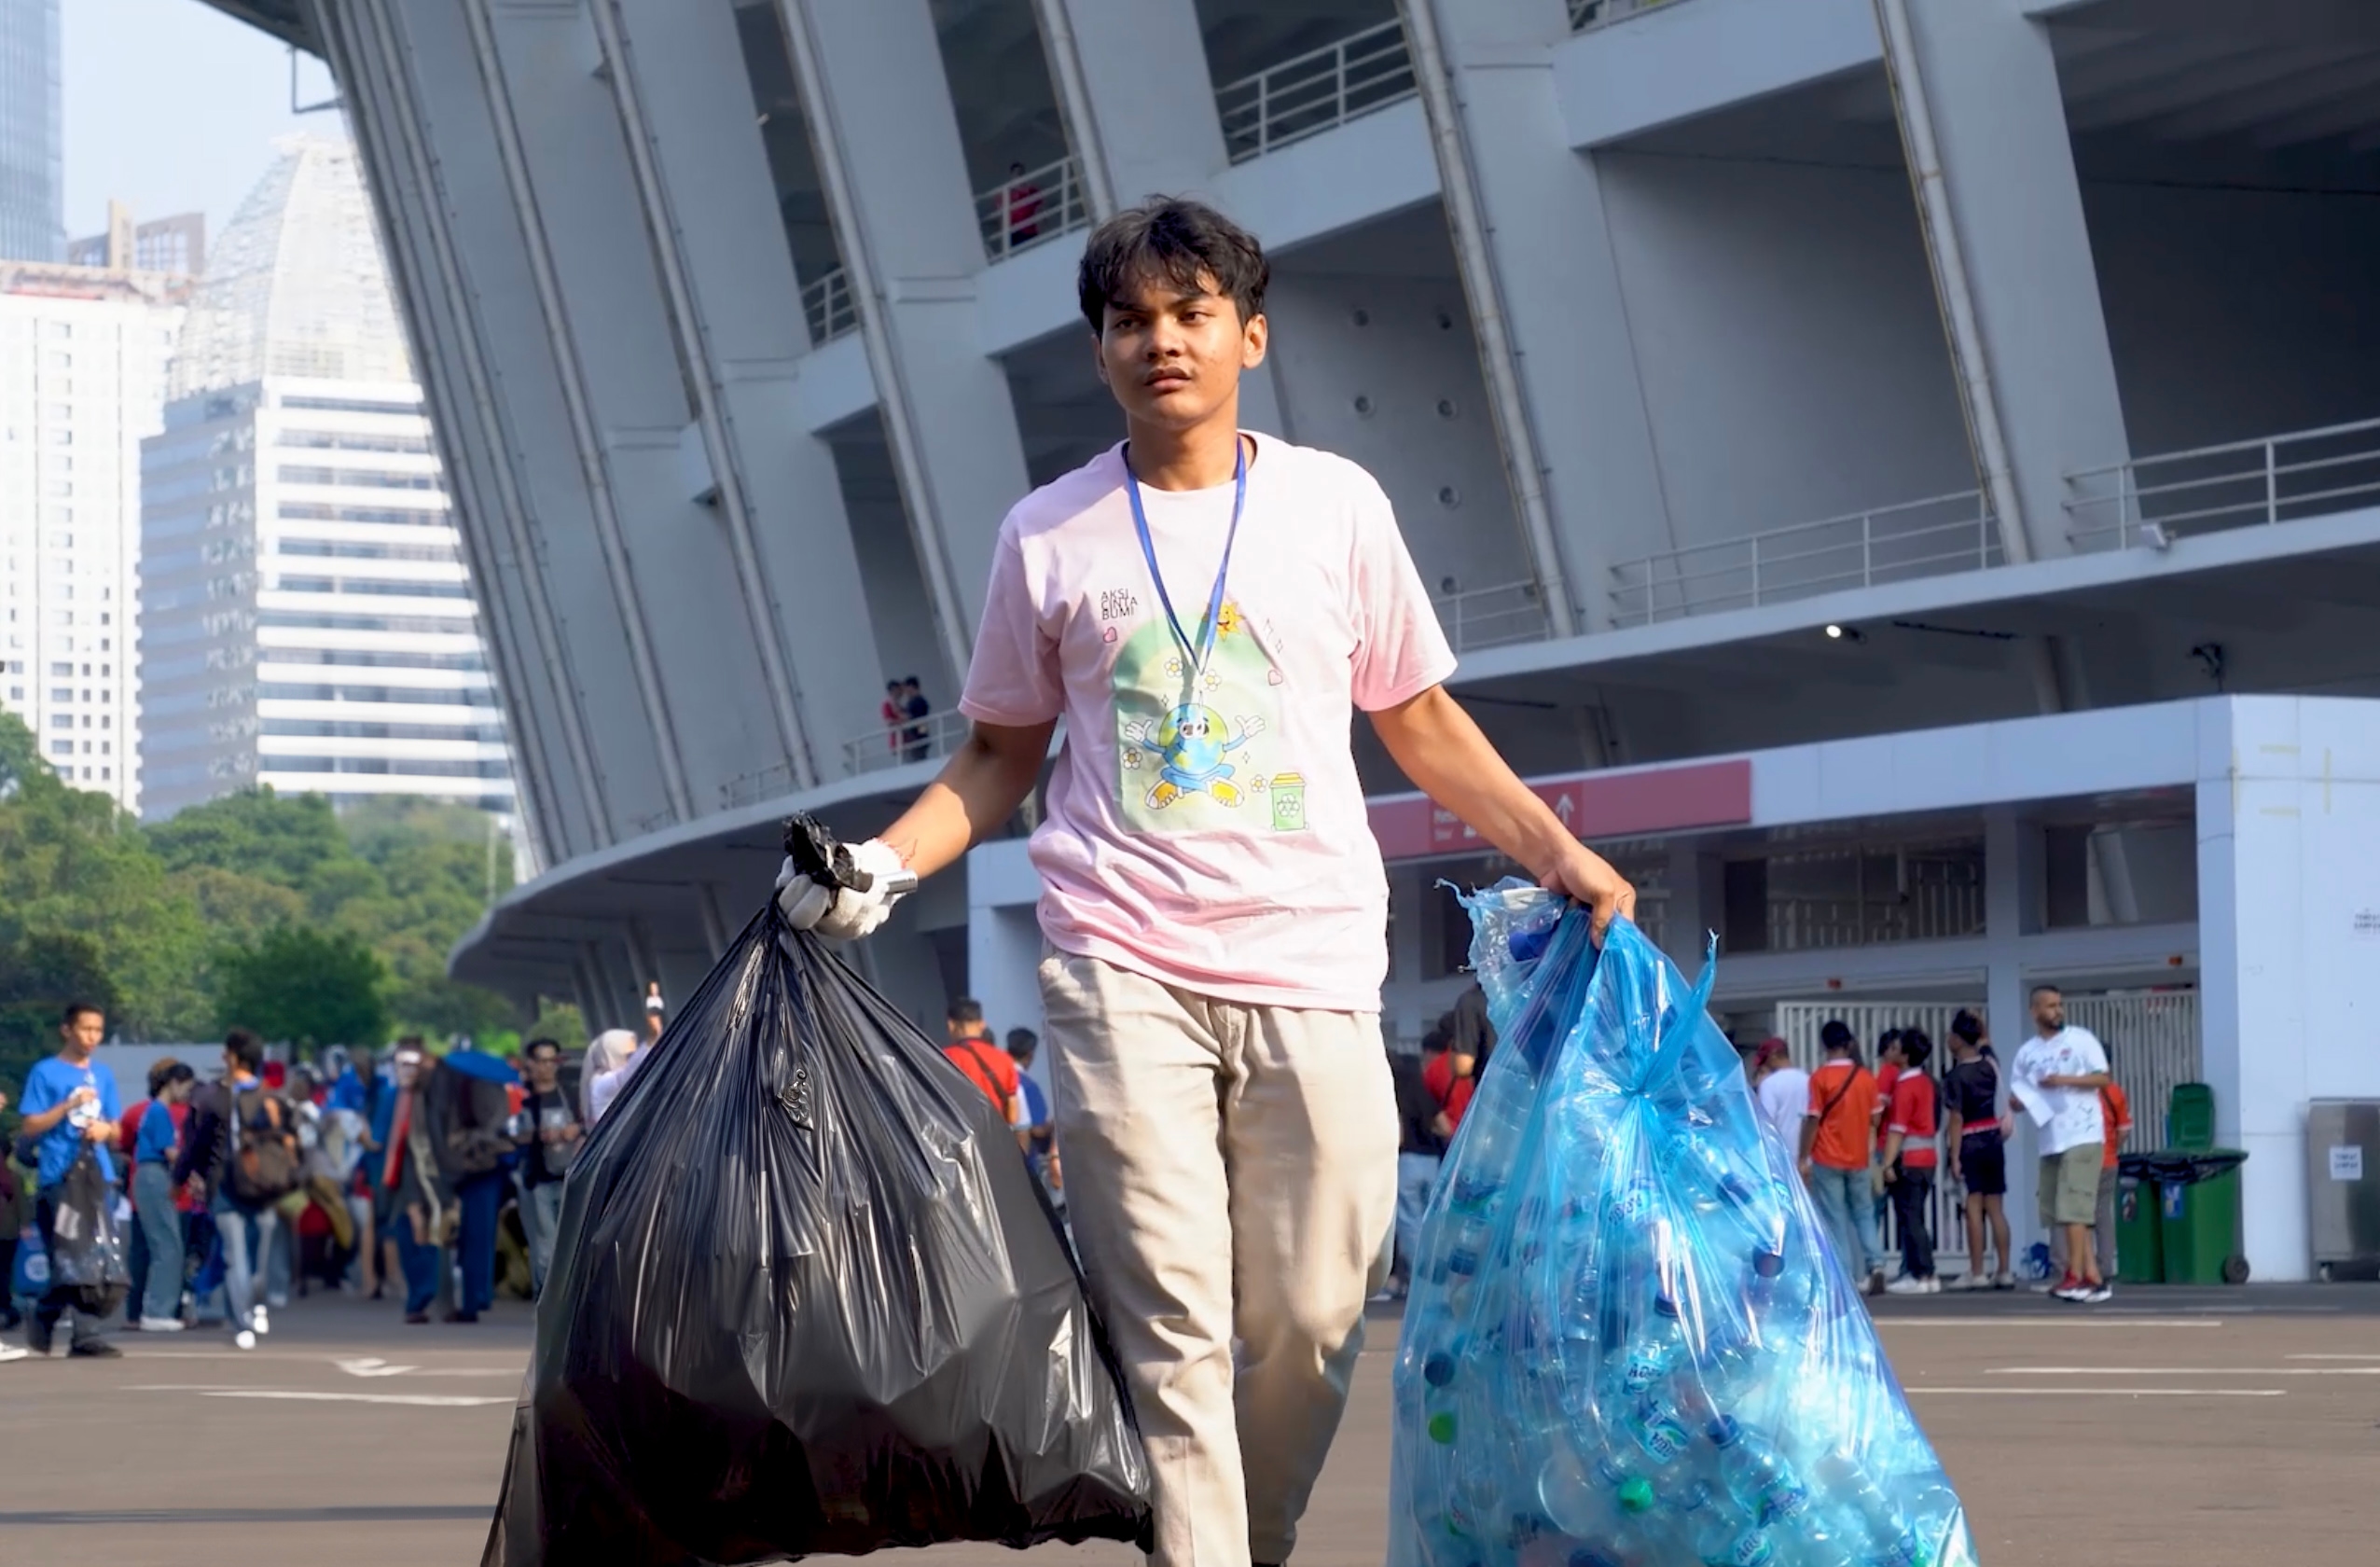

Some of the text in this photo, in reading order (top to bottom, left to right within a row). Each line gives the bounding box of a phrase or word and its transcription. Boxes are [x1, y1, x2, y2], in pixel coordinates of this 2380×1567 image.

[1100, 588, 1129, 601] AKSI
[1100, 596, 1139, 610] CINTA
[1101, 606, 1134, 620] BUMI
[1735, 1531, 1762, 1562] AQU
